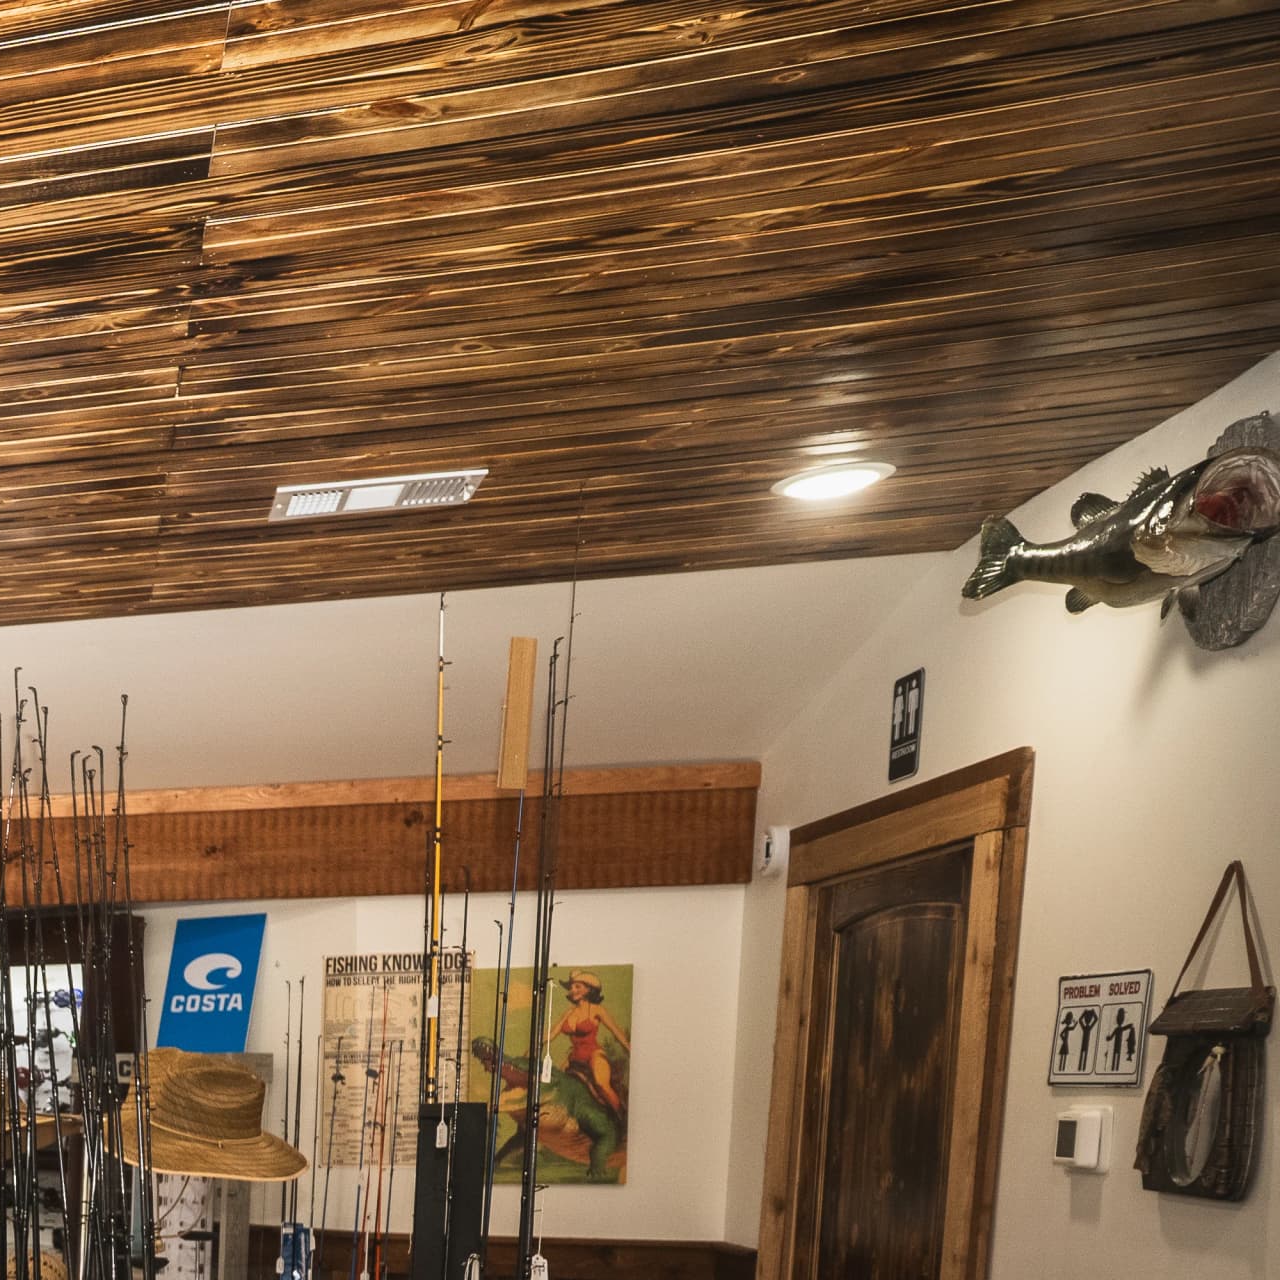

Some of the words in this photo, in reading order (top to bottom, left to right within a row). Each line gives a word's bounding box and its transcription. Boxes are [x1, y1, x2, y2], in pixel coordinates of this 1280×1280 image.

[326, 956, 377, 973] FISHING
[383, 952, 472, 971] KNOWEDGE
[326, 974, 341, 987] HOW
[343, 976, 352, 985] TO
[399, 974, 421, 985] RIGHT
[1063, 984, 1101, 1000] PROBLEM
[1108, 981, 1141, 996] SOLVED
[170, 994, 243, 1014] COSTA
